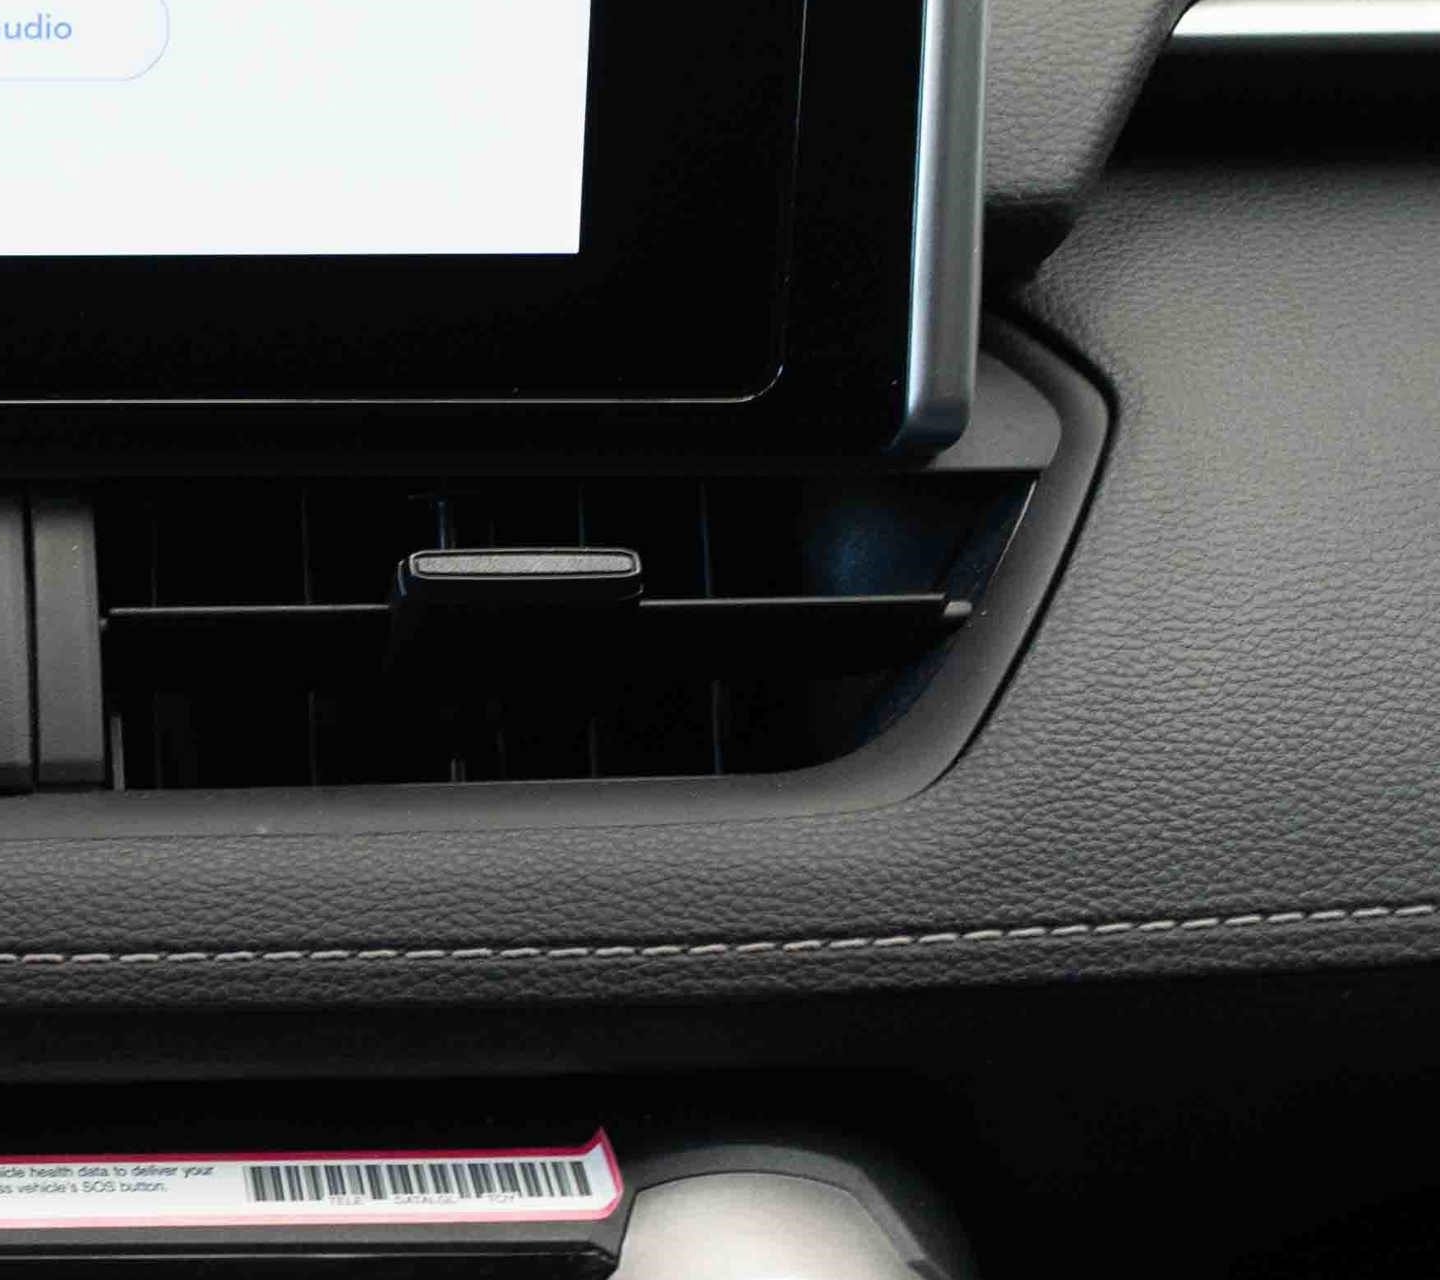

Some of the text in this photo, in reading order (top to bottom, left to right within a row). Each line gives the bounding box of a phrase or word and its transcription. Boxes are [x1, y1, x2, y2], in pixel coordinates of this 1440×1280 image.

[29, 1165, 71, 1179] health
[78, 1165, 108, 1179] data
[113, 1165, 127, 1178] to
[131, 1165, 178, 1178] deliver
[183, 1166, 214, 1180] your
[81, 1180, 115, 1194] SOS
